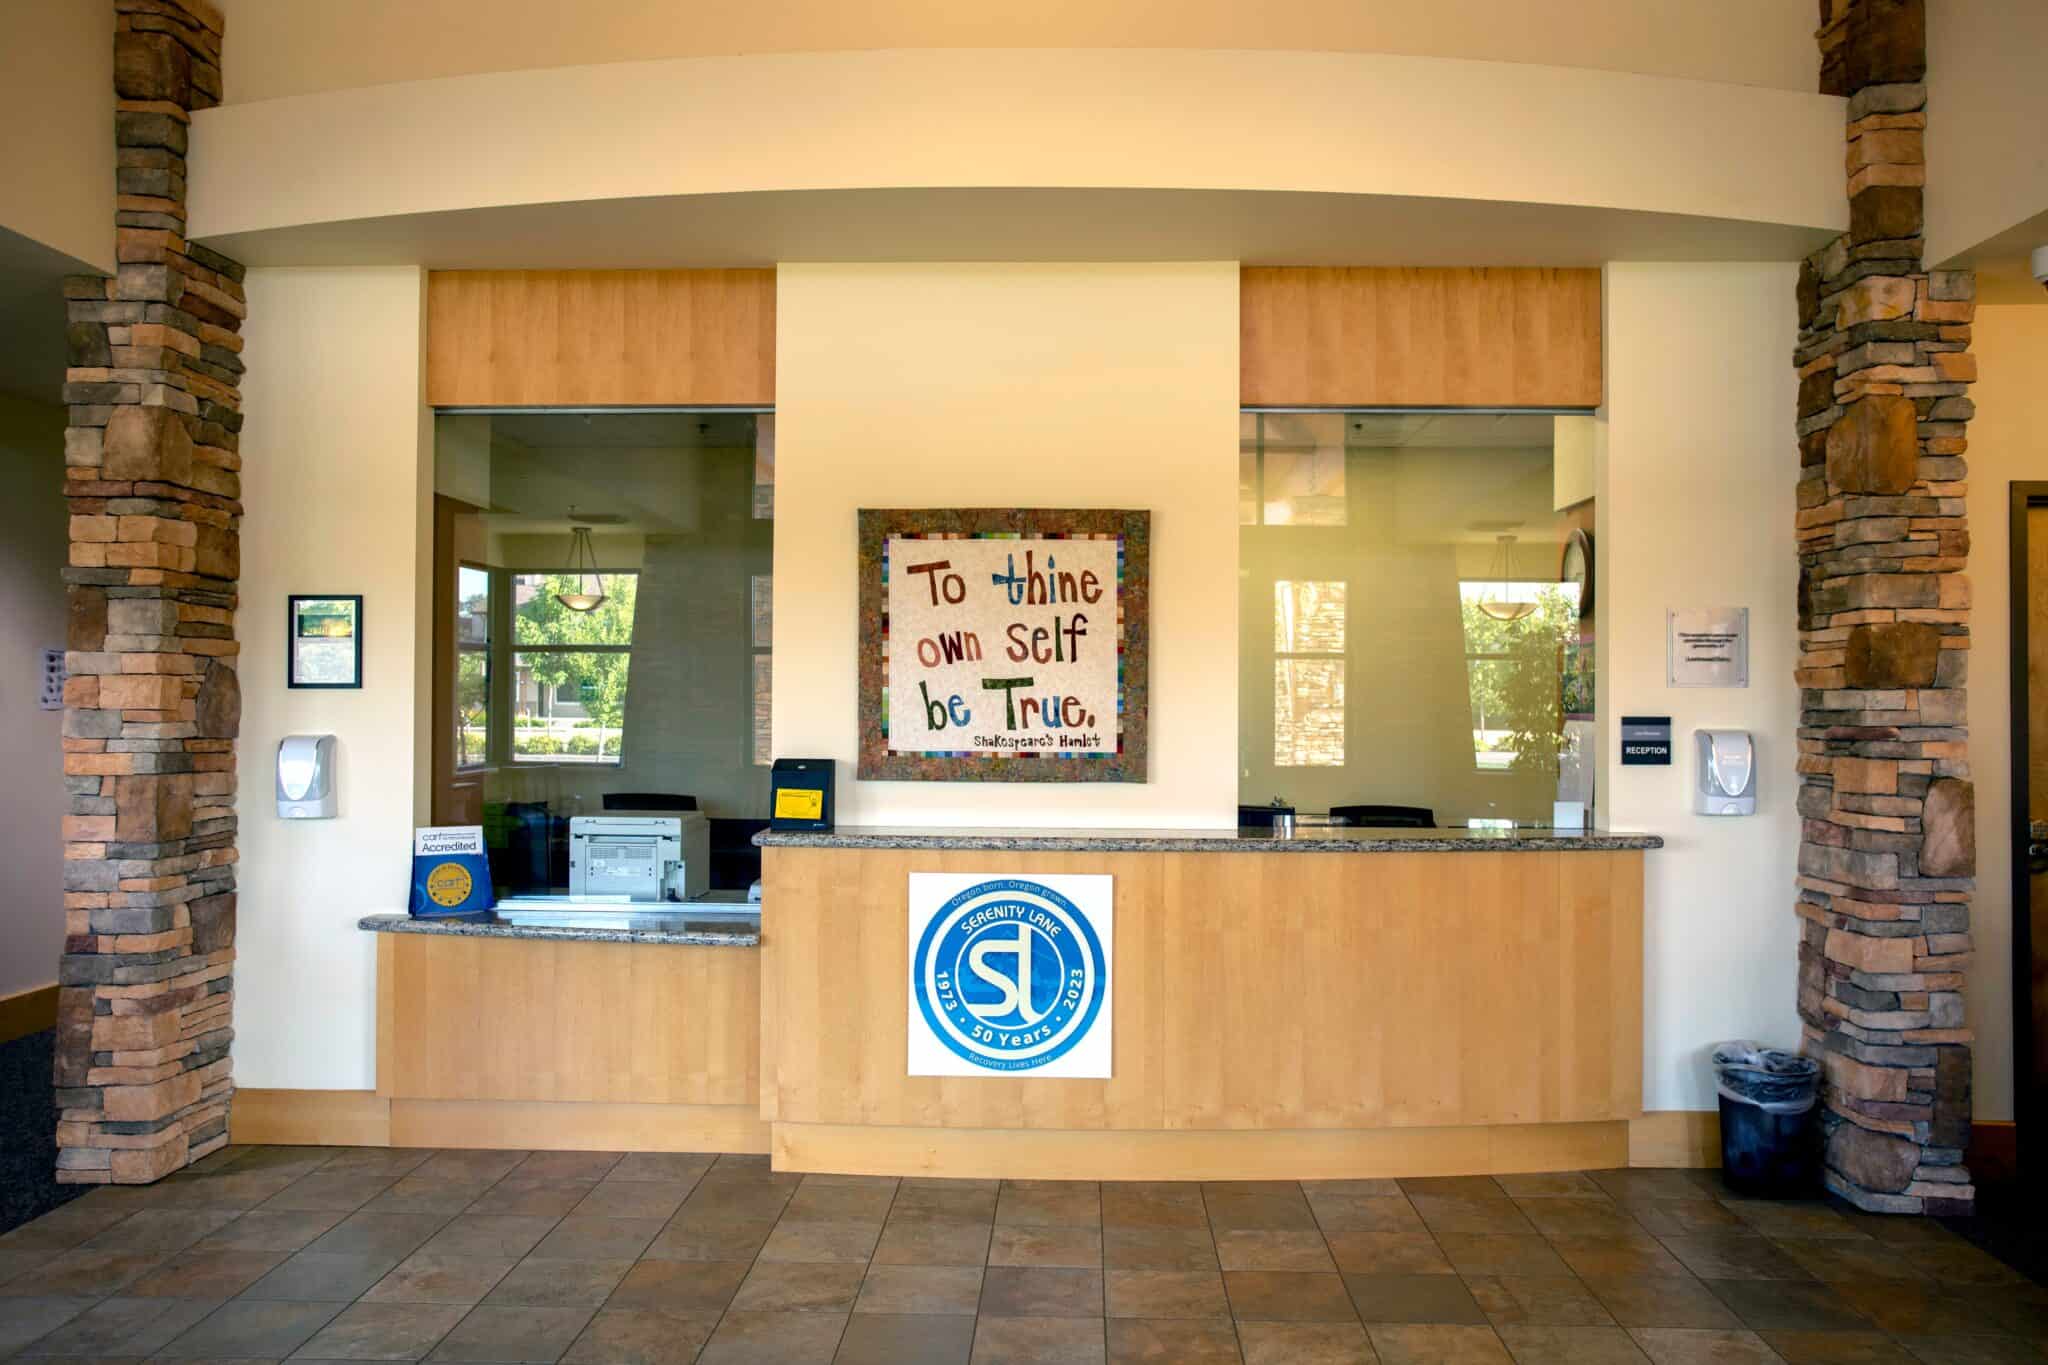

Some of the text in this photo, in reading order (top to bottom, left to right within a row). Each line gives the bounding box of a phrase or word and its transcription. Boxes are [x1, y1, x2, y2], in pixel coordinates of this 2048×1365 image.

[907, 550, 1103, 606] To thine
[917, 630, 983, 668] own
[919, 677, 1096, 731] be True.
[1059, 733, 1101, 747] Hamlet
[1625, 746, 1668, 755] RECEPTION
[422, 841, 477, 852] Accredited
[951, 886, 982, 906] Oregon
[1008, 880, 1040, 893] Oregon
[961, 905, 1062, 938] SERENITY LANE
[936, 968, 1083, 1047] 1973 50 Years 2023
[968, 1052, 1006, 1070] Recovery
